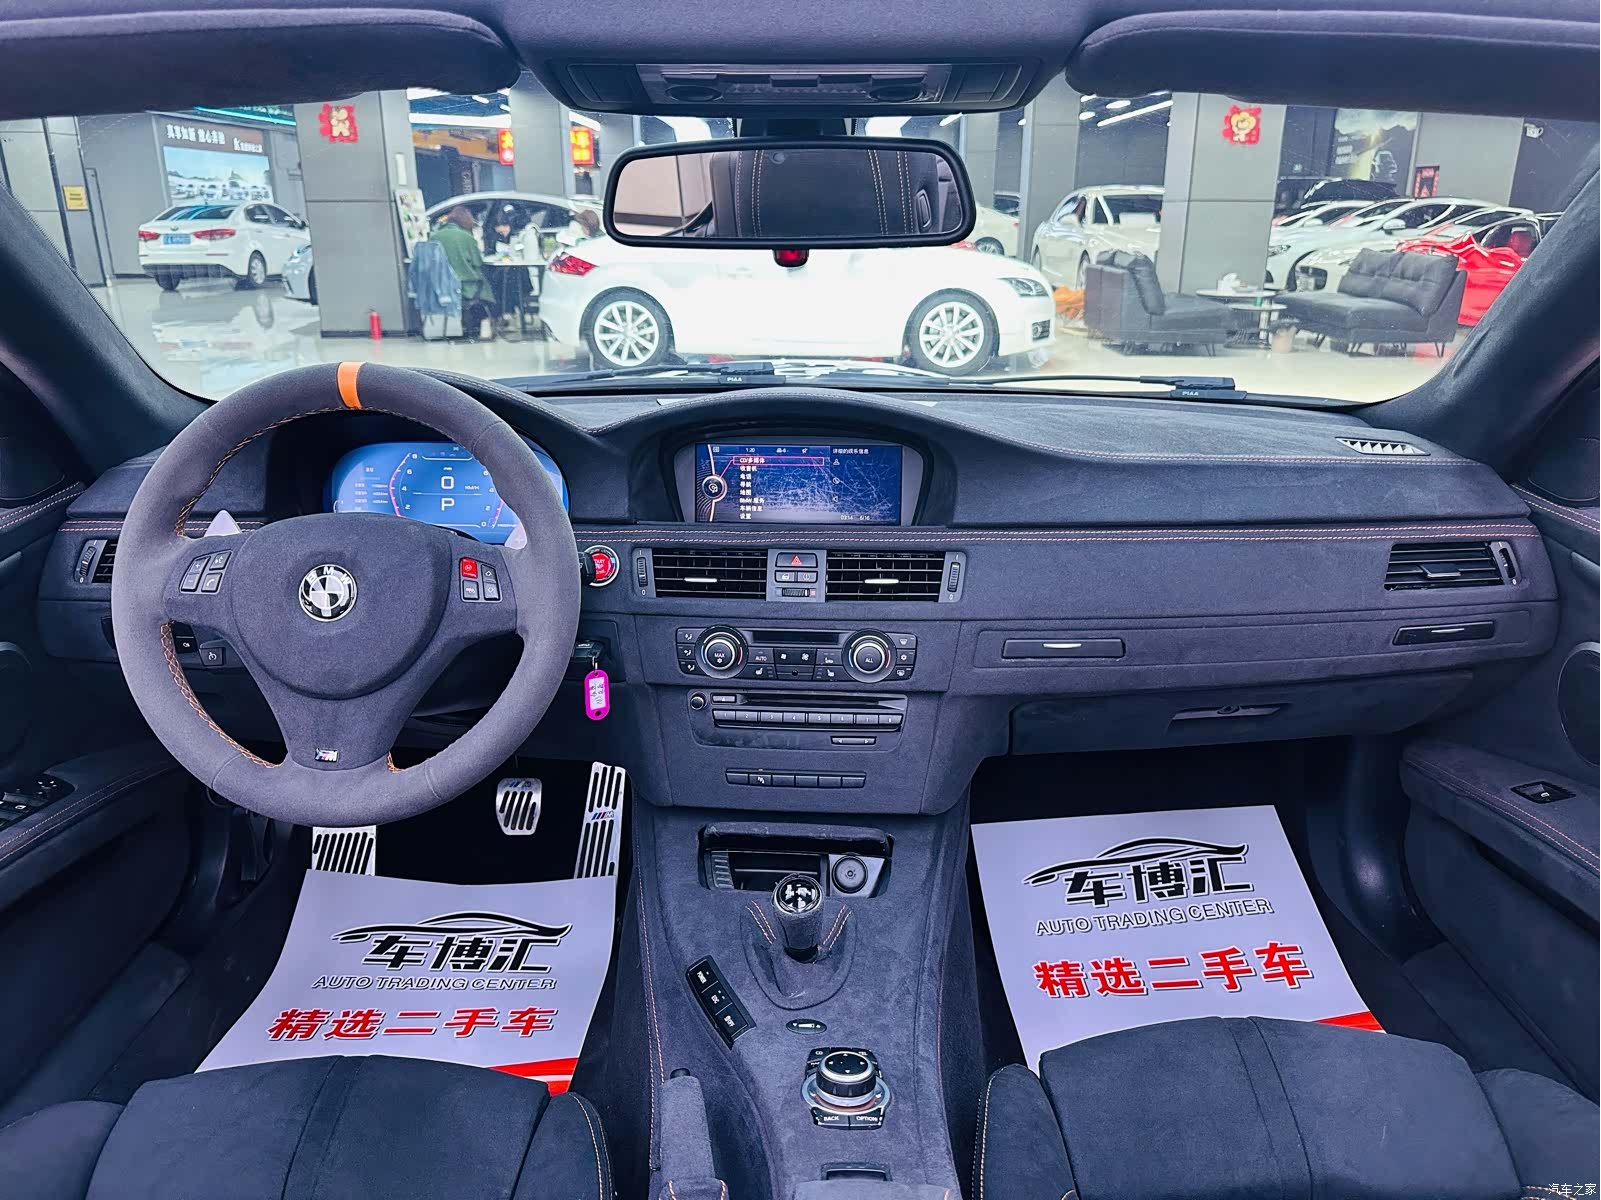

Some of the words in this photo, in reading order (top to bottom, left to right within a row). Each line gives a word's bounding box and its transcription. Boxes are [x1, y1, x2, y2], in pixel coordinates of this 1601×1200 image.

[441, 498, 455, 511] P
[305, 566, 351, 585] BMW
[1064, 855, 1255, 907] 车博汇
[1036, 917, 1093, 935] AUTO
[1093, 907, 1187, 931] TRADING
[1188, 899, 1274, 922] CENTER
[361, 934, 560, 972] 车博汇
[1033, 942, 1314, 999] 精选二手车
[312, 975, 371, 990] AUTO
[375, 976, 468, 991] TRADING
[471, 978, 558, 991] CENTER
[267, 1007, 558, 1041] 精选二手车
